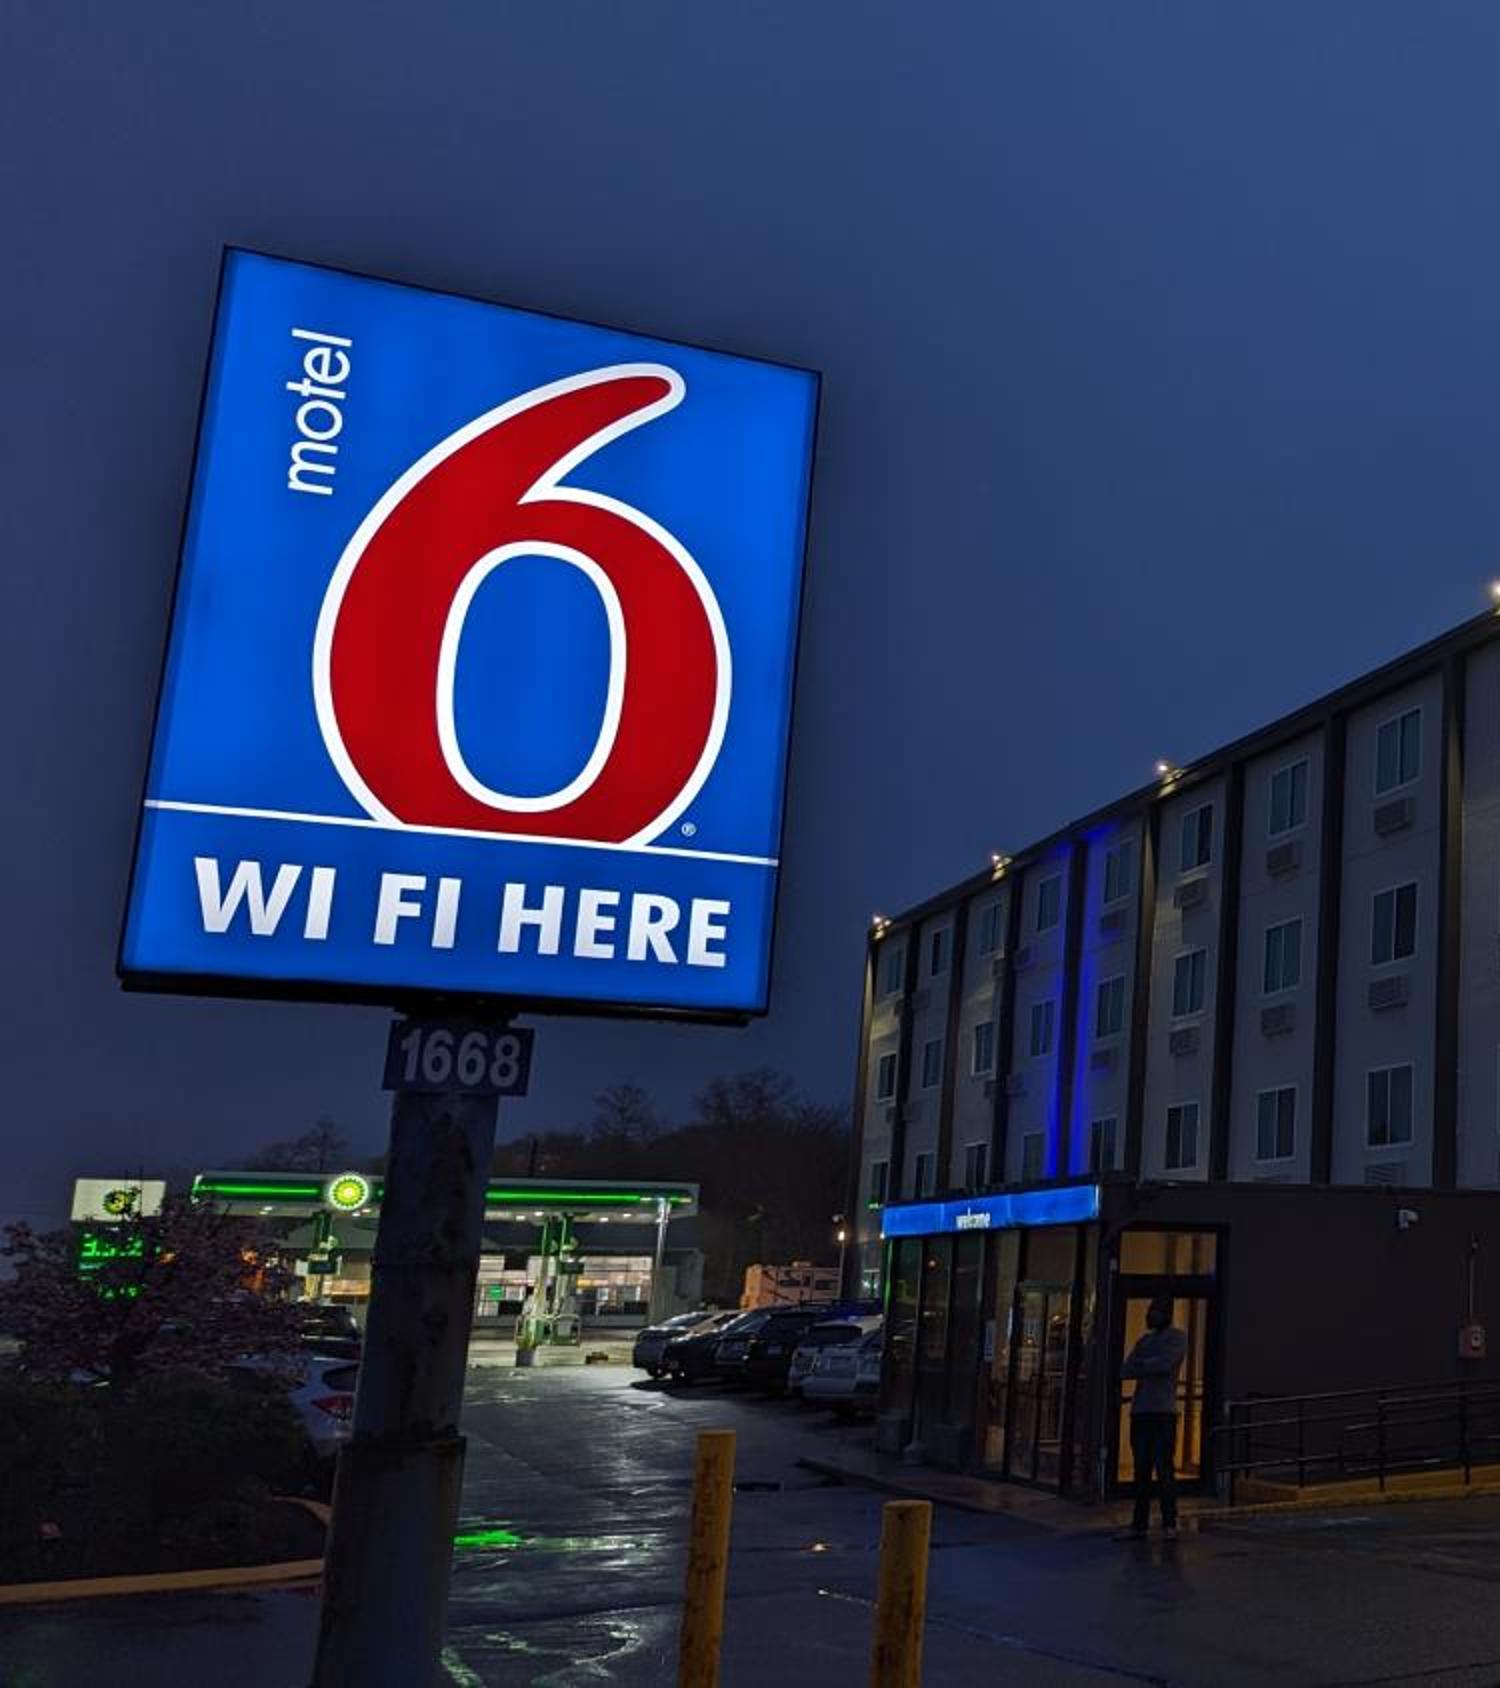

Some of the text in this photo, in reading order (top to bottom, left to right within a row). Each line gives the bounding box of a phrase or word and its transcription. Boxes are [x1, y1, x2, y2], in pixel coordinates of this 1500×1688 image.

[286, 329, 352, 495] motel
[312, 363, 732, 847] 6
[194, 857, 731, 967] WI FI HERE
[401, 1027, 521, 1087] 1668
[956, 1208, 991, 1230] welcome
